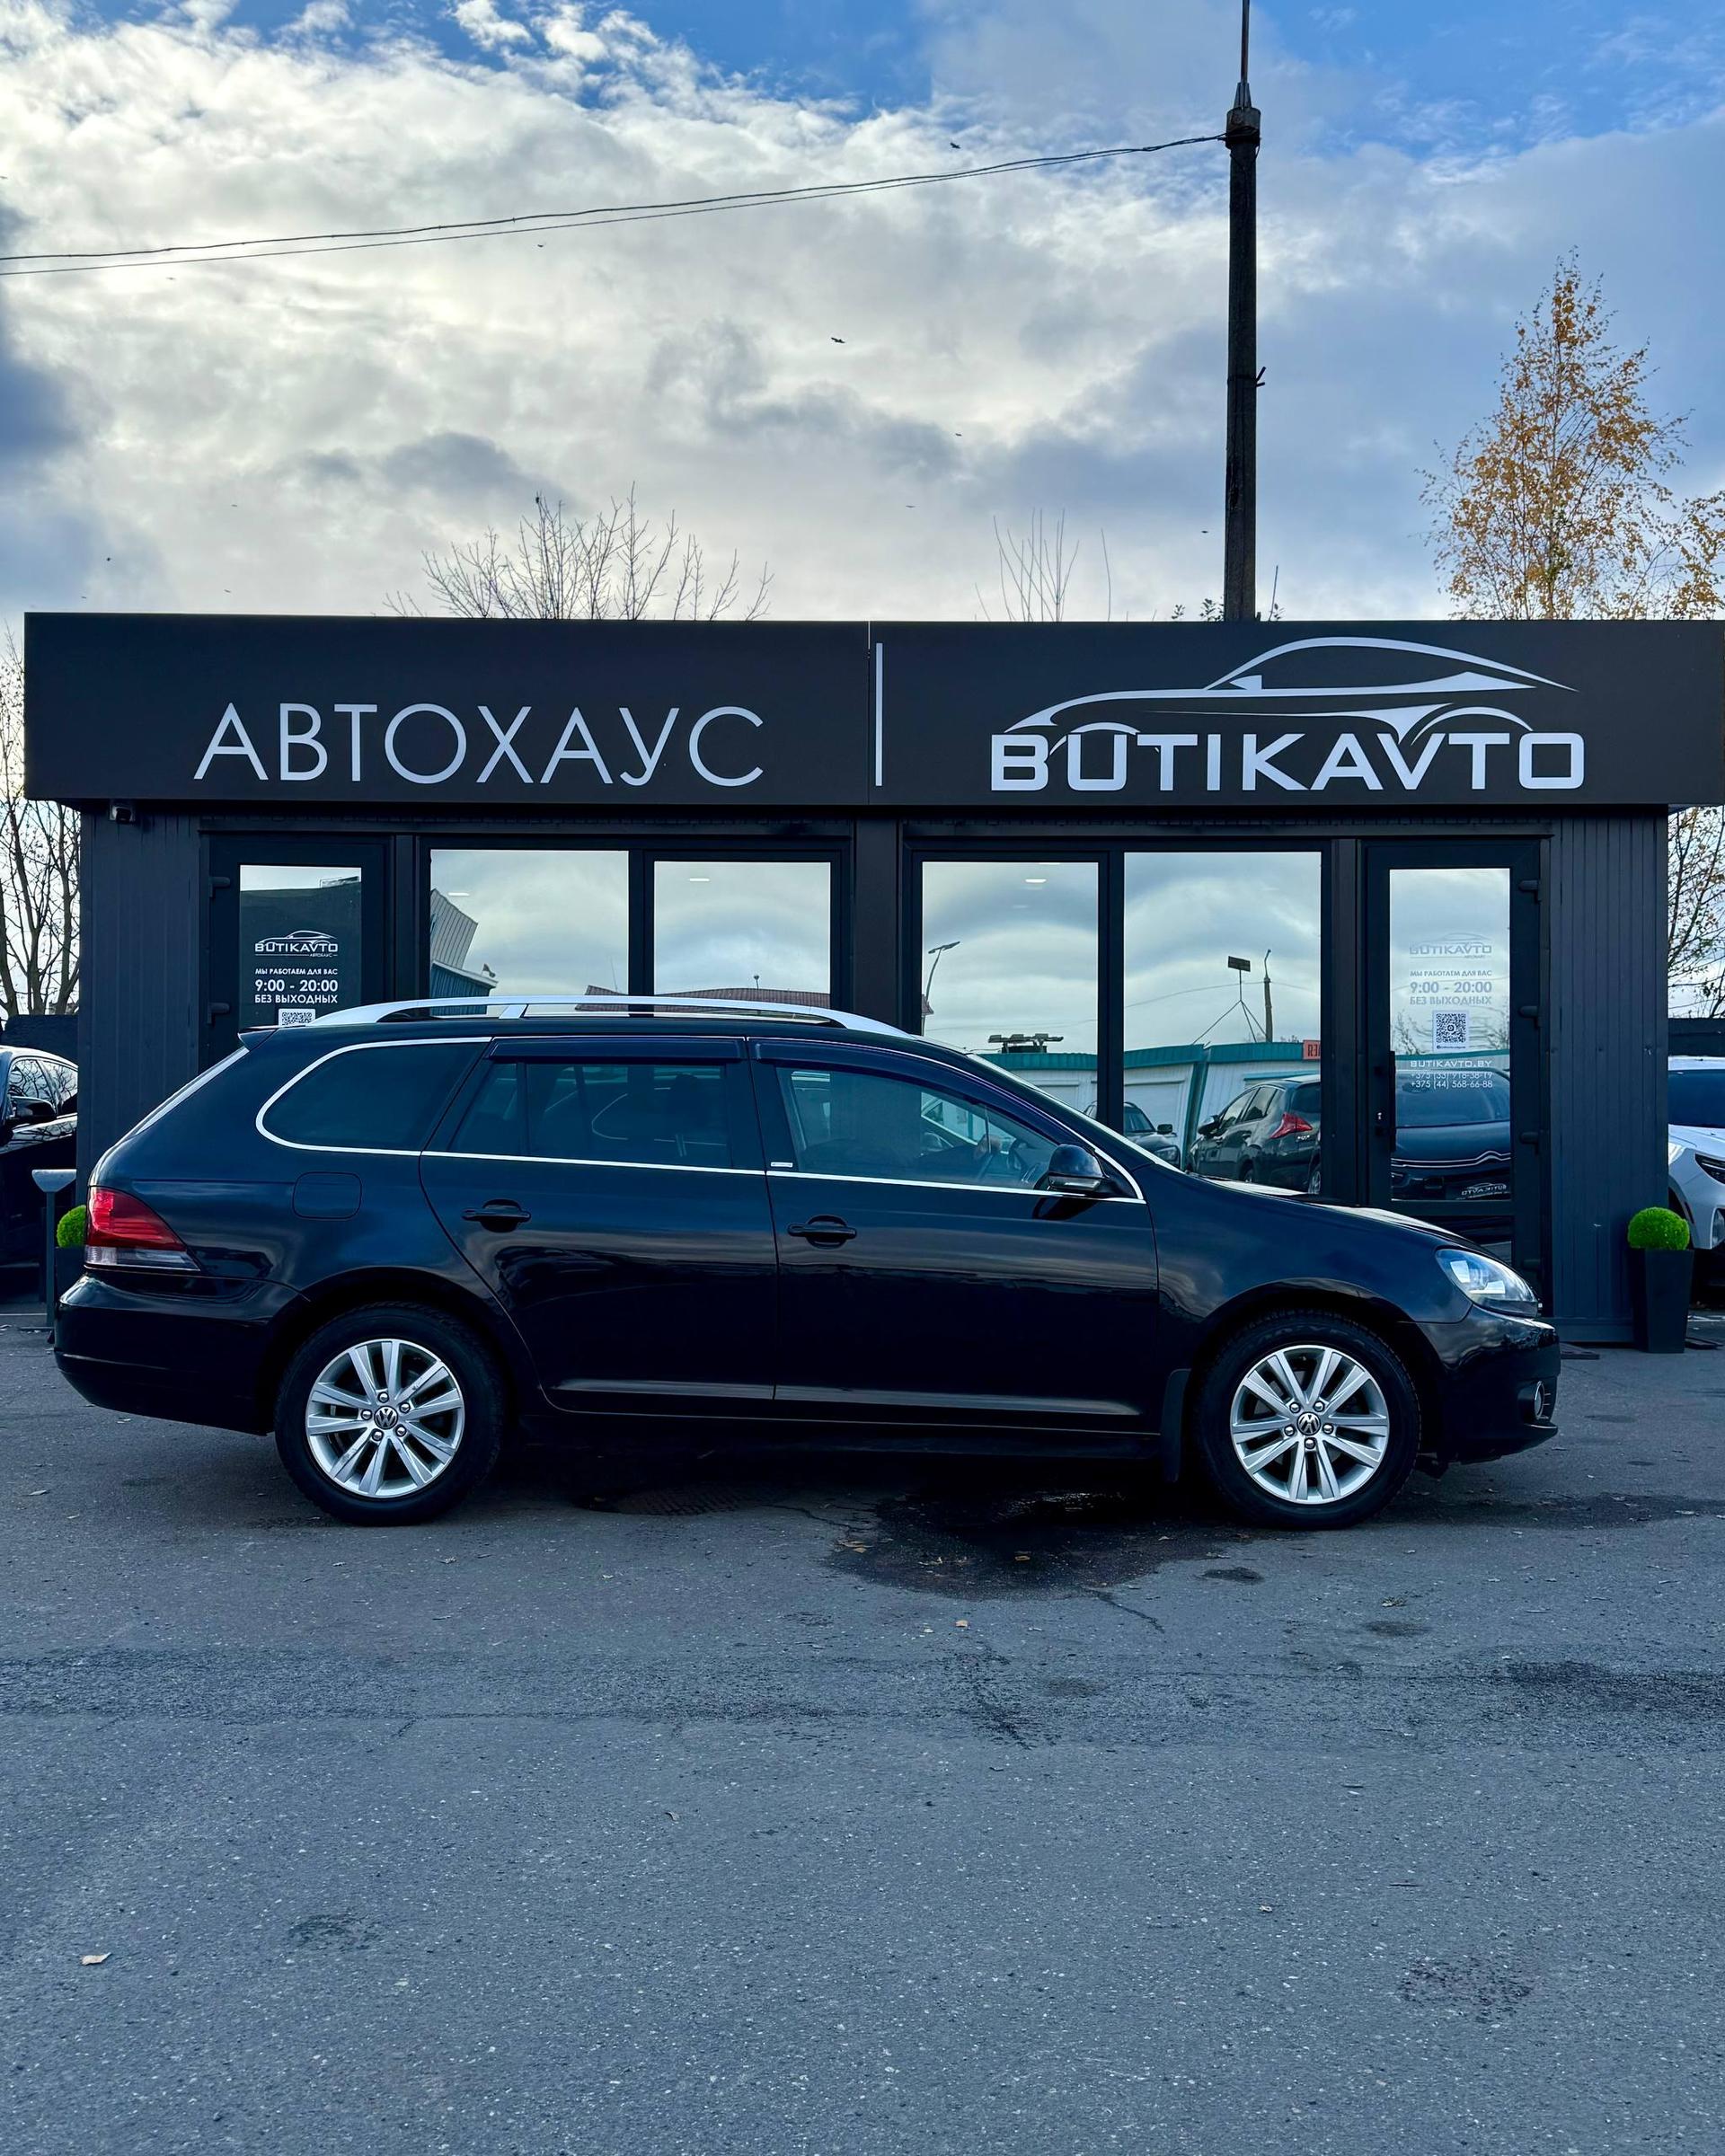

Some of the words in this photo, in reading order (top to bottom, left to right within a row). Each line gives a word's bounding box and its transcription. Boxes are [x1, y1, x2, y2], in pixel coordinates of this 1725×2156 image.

[192, 702, 765, 788] АВТОХАУС
[990, 730, 1586, 792] BUTIKAVTO
[254, 942, 339, 952] BUTIKAVTO
[307, 968, 322, 976] ДЛЯ
[254, 979, 285, 992] 9:00
[299, 979, 339, 992] 20:00
[1410, 981, 1439, 994] 9:00
[1454, 981, 1492, 994] 20:00
[254, 994, 272, 1003] БЕЗ
[275, 994, 338, 1004] ВЫХОДНЫХ
[1410, 996, 1427, 1005] БЕЗ
[1429, 996, 1492, 1006] ВЫХОДНЫХ
[1411, 1080, 1430, 1088] +375
[1433, 1079, 1449, 1090] (44)
[1452, 1080, 1493, 1088] 568-66-88
